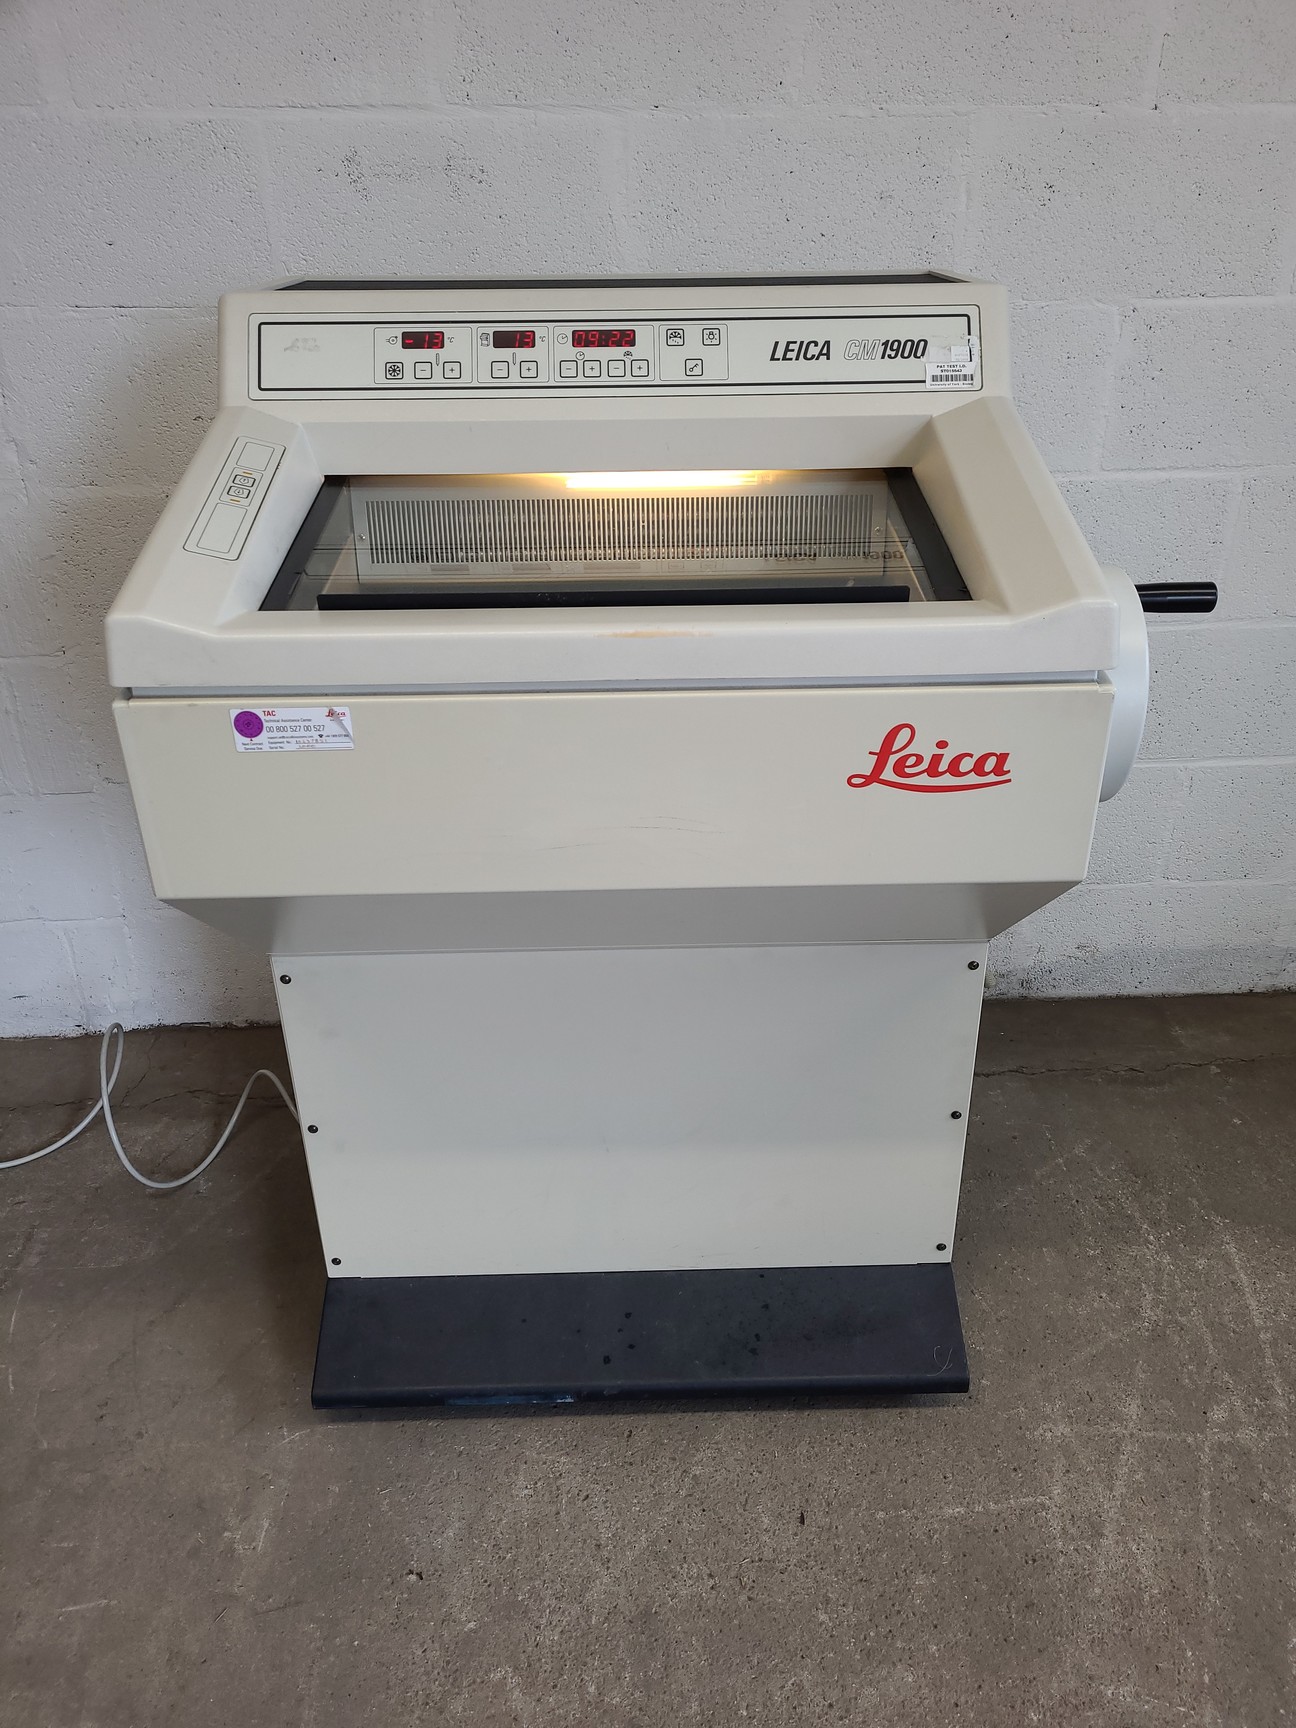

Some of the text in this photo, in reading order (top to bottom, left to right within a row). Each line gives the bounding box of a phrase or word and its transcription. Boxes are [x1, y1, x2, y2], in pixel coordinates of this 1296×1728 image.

[573, 330, 635, 348] 09:22
[769, 338, 929, 361] LEICA CM1900
[846, 722, 1012, 793] Leica
